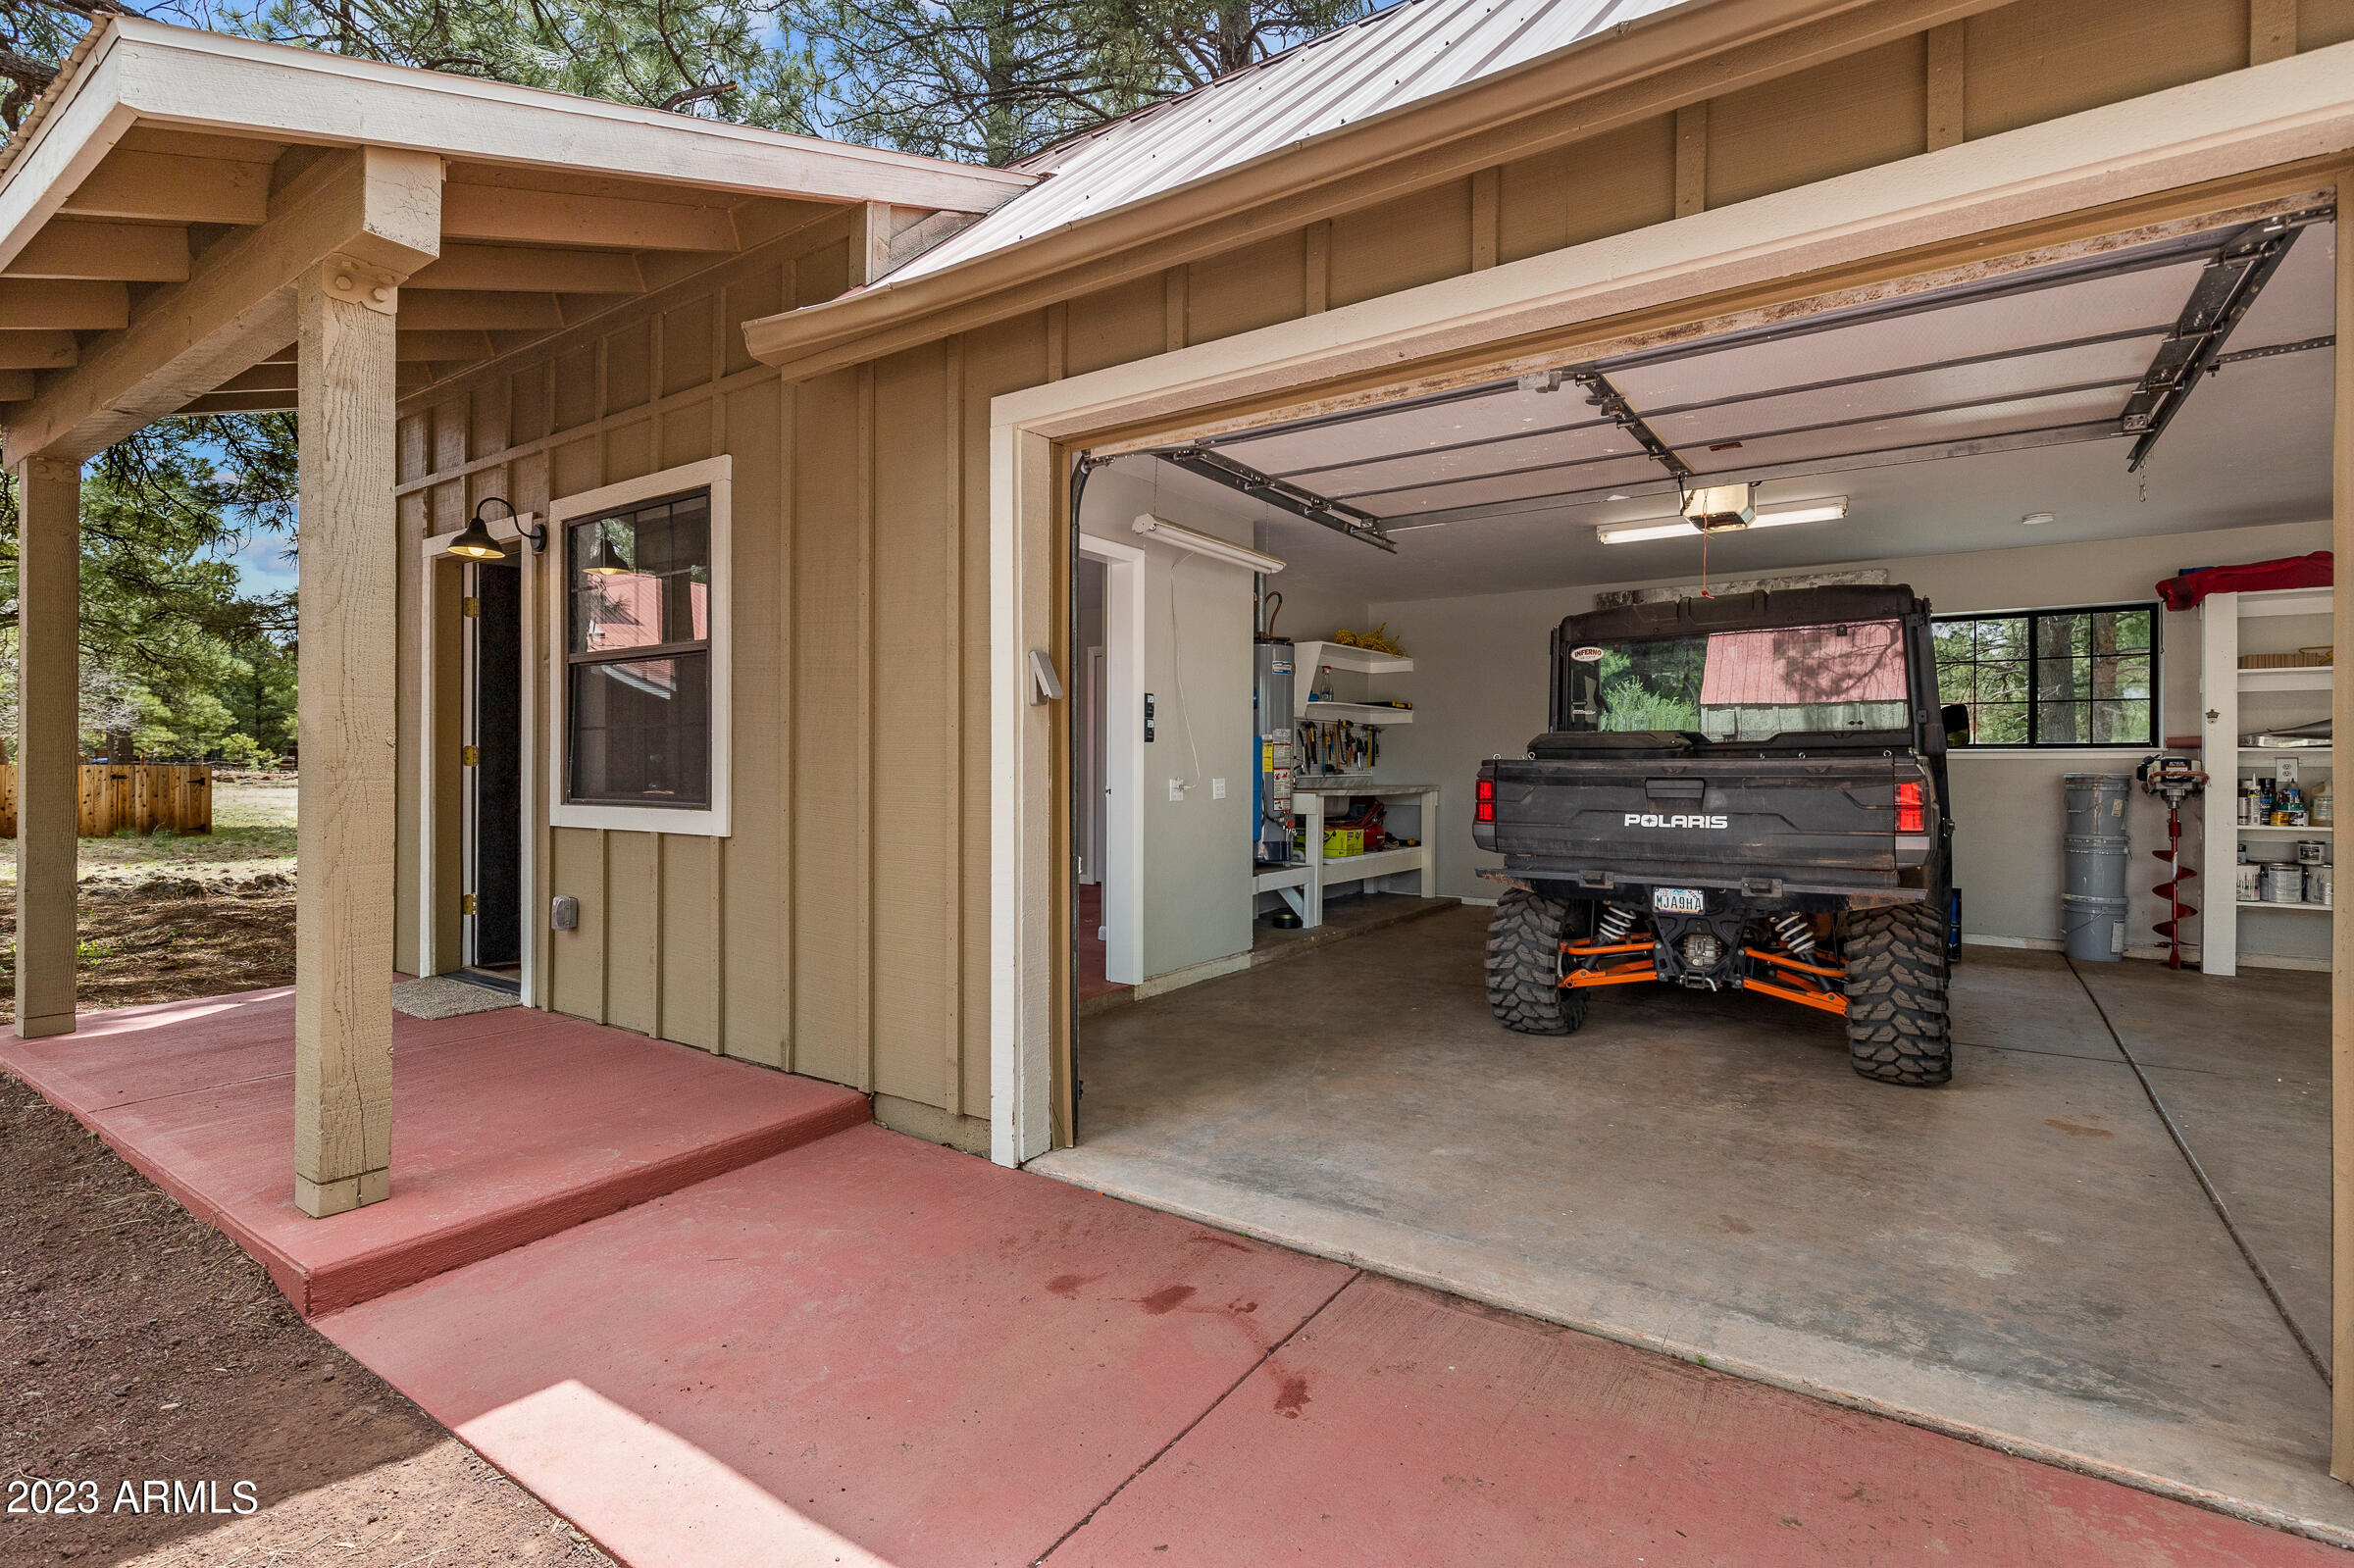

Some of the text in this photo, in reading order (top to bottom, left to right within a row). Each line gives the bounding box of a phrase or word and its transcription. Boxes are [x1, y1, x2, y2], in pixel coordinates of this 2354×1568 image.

[1574, 648, 1602, 657] INFERNO
[1624, 813, 1728, 830] POLARIS
[1657, 894, 1702, 911] MJA9HA
